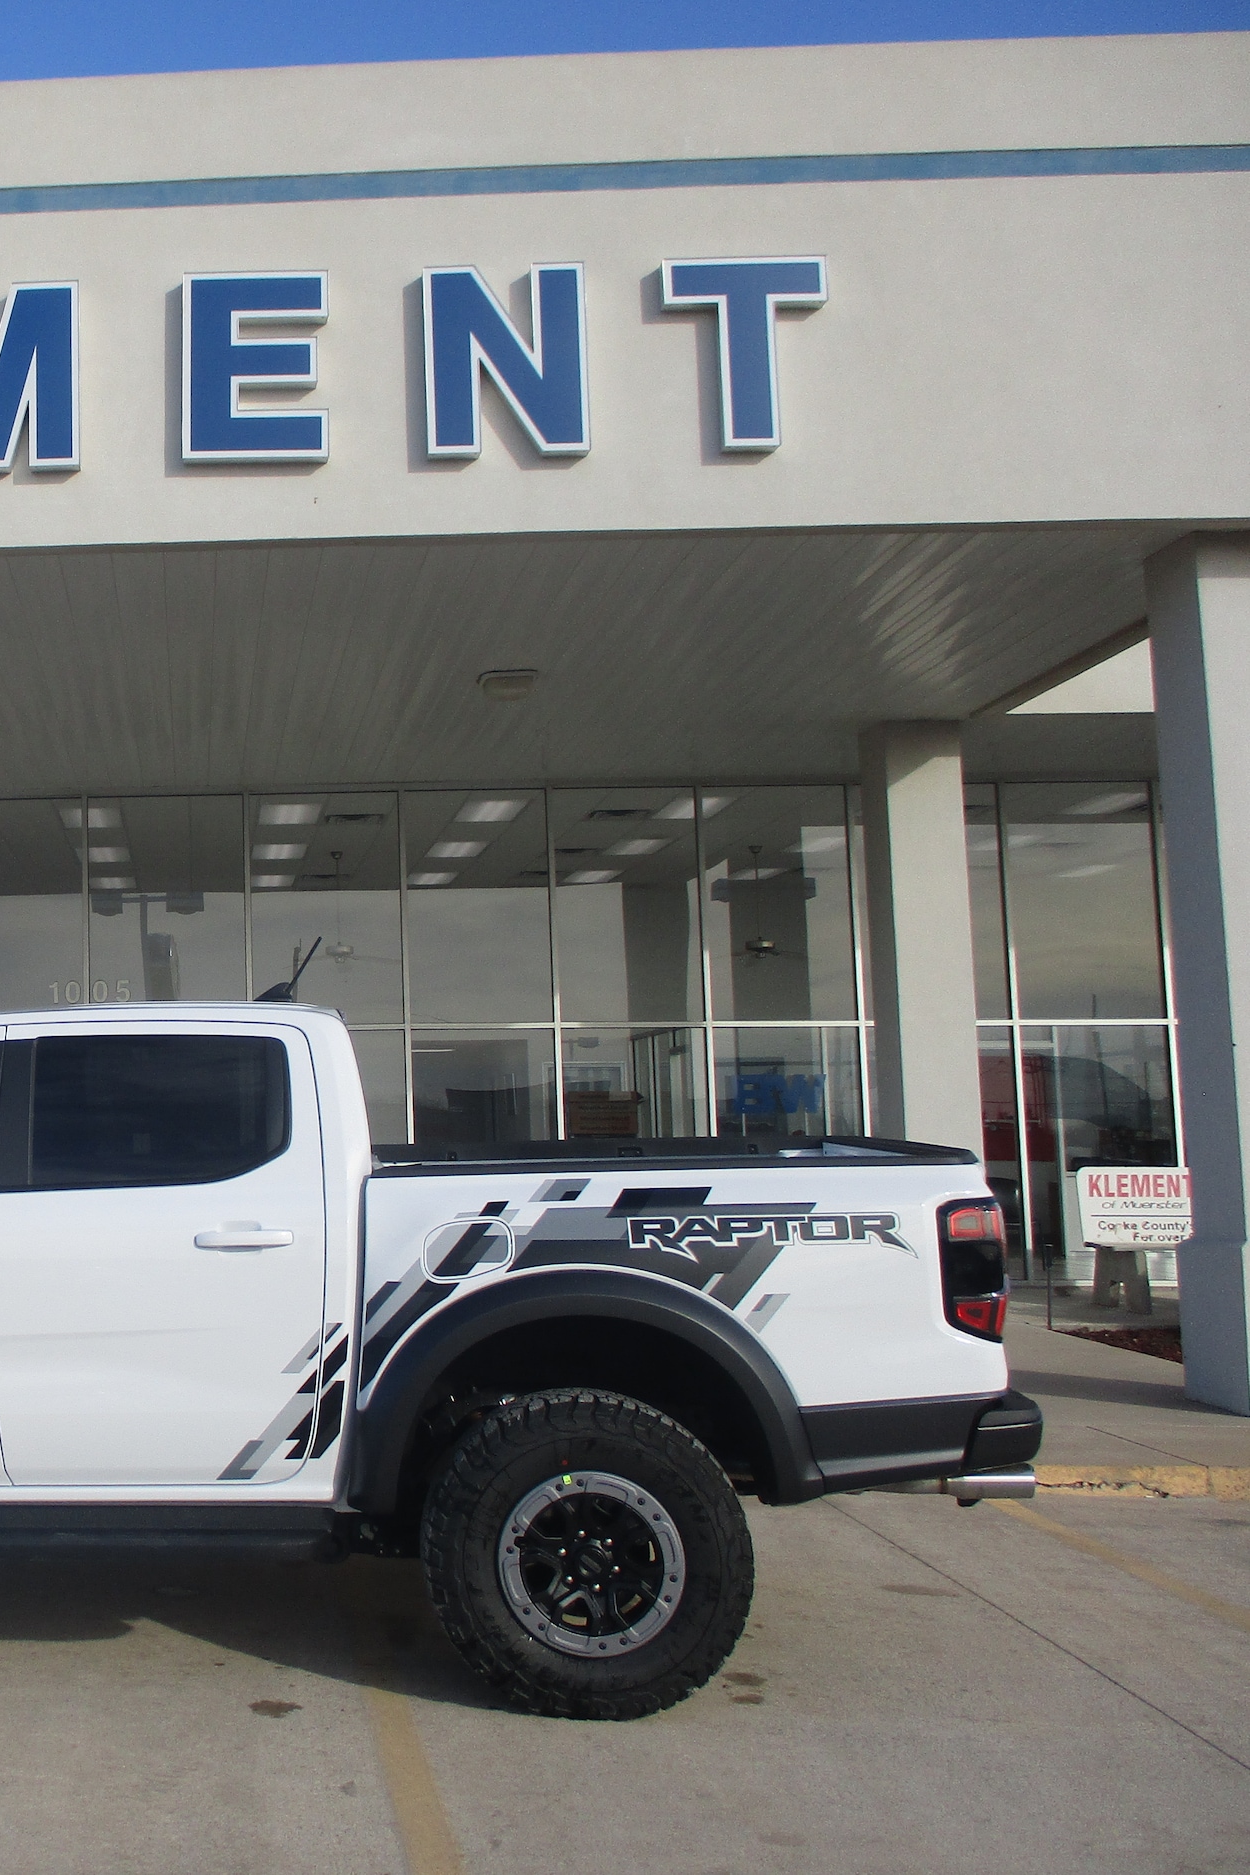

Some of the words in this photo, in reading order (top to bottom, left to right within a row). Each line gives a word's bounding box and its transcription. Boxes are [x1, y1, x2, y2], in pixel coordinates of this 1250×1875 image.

[48, 979, 132, 1005] 1005
[1087, 1174, 1192, 1198] KLEMENT
[1101, 1200, 1116, 1210] of
[1120, 1200, 1187, 1210] Muenster
[1098, 1220, 1138, 1231] Coke
[626, 1210, 919, 1264] RAPTOR
[1133, 1232, 1154, 1242] For
[1157, 1234, 1186, 1242] over
